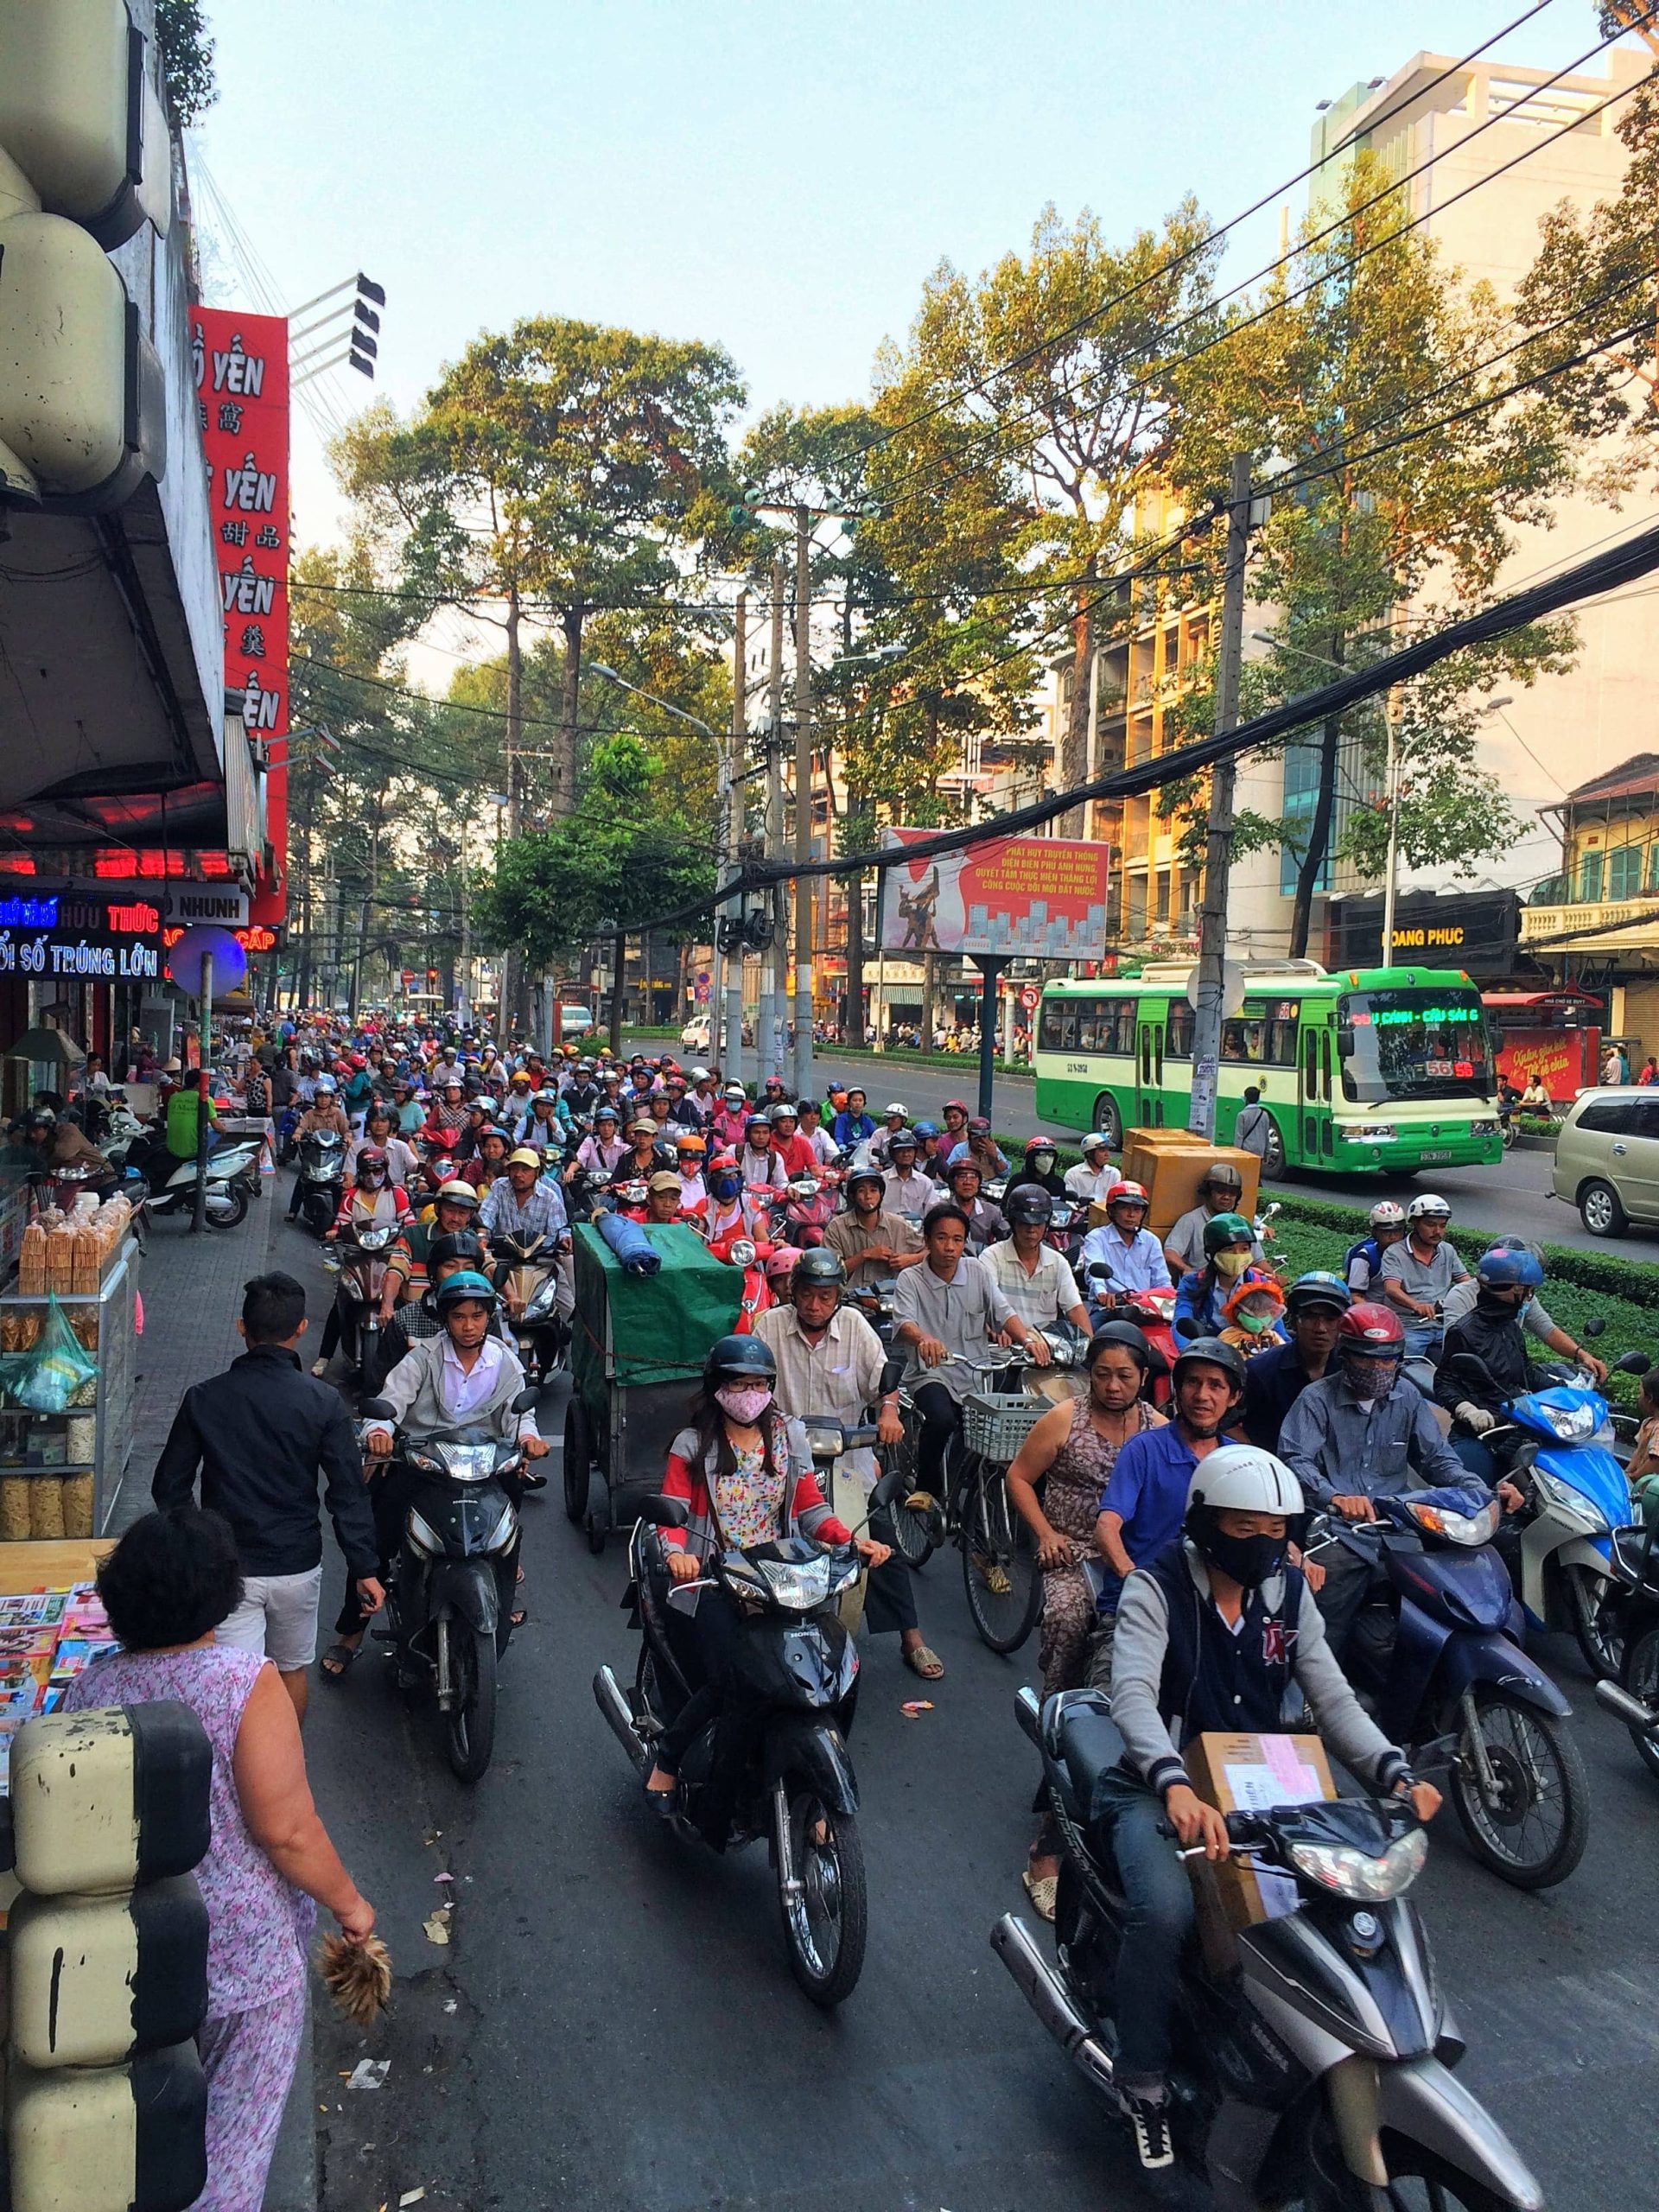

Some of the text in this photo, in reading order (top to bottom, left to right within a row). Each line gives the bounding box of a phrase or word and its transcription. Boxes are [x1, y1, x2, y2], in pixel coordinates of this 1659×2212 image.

[213, 334, 264, 397] YẾN
[225, 452, 277, 513] YẾN
[222, 521, 281, 549] 甜品
[223, 555, 275, 614] YẾN
[243, 670, 280, 729] ẾN
[107, 901, 159, 933] THỨC
[180, 895, 240, 919] NHUNH
[19, 935, 48, 972] SỐ
[50, 939, 116, 974] TRÚNG
[120, 942, 158, 977] LỚN
[1381, 930, 1425, 947] OANG
[1427, 1062, 1450, 1076] 56
